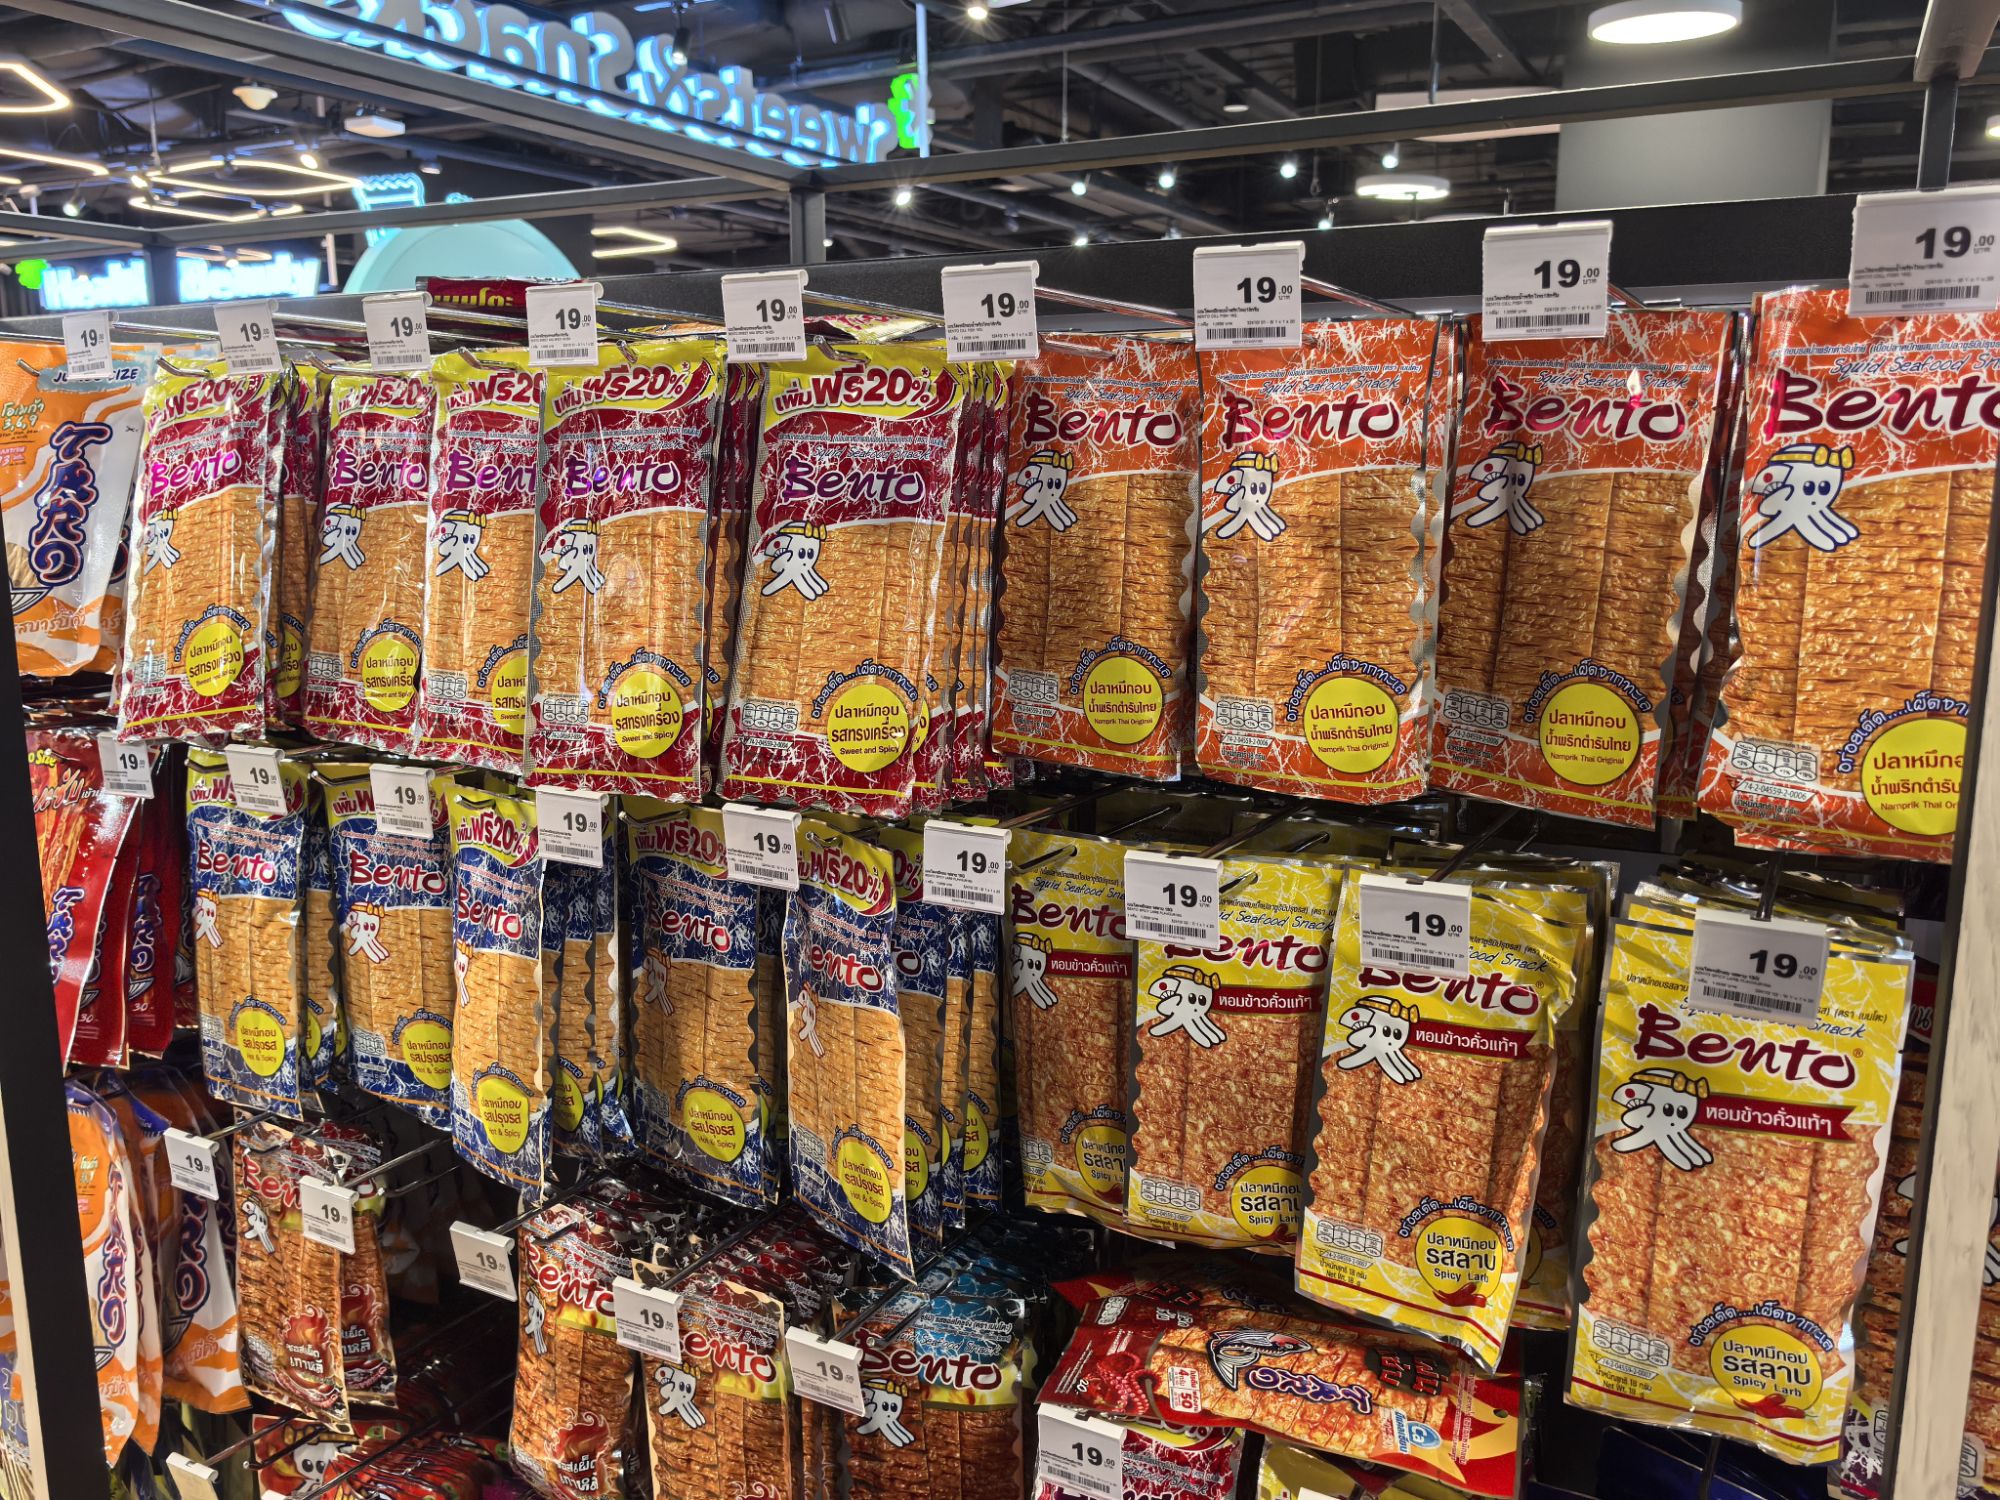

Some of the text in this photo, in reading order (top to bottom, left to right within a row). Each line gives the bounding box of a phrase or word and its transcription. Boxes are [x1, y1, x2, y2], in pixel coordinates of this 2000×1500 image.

[1915, 226, 1995, 259] 19 .00
[1534, 259, 1600, 289] 19 .00
[1237, 276, 1293, 303] 19 .00
[756, 298, 785, 323] 19
[981, 293, 1015, 318] 19
[391, 317, 413, 337] 19
[555, 308, 580, 330] 19
[81, 329, 98, 348] 19
[241, 323, 262, 344] 19
[1830, 355, 1967, 382] Squid Seafood
[1260, 374, 1401, 395] Squid Seafood Snack
[1535, 371, 1690, 389] Squid Snack
[1064, 386, 1092, 402] Squid
[1145, 387, 1182, 401] Snack
[1023, 391, 1184, 448] Bento
[1482, 375, 1687, 442] Bento
[1220, 390, 1402, 452] Bento
[151, 450, 241, 498] Bento
[332, 447, 428, 489] Bento
[447, 449, 537, 492] Bent
[563, 456, 680, 497] Bento
[782, 454, 926, 502] Bento
[28, 421, 113, 587] TARO
[1090, 680, 1152, 695] ปลาหมึกอบ
[616, 690, 671, 708] ปลาหมึกอบ
[1088, 696, 1157, 714] น้ำพริกตำรับไทย
[615, 703, 680, 731] รสทรงเครื่อง
[834, 703, 899, 719] ปลาหมึกอบ
[1310, 702, 1386, 720] ปลาหมึกอบ
[1549, 710, 1626, 729] ปลาหมึกอบ
[654, 731, 674, 741] Spicy
[831, 717, 906, 742] รสทรงเครื่อง
[1310, 723, 1393, 741] น้ำพริกตำรับไทย
[1546, 728, 1632, 752] น้ำพริกตำรับไทย
[840, 746, 899, 755] Sweet and Spicy
[1362, 742, 1390, 751] Original
[119, 753, 139, 770] 19
[1550, 752, 1625, 765] Namprik Thai Original
[1873, 749, 1964, 770] ปลาหมึกอ
[250, 767, 269, 785] 19
[395, 785, 416, 805] 19
[1880, 800, 1942, 812] Namprik Thai
[563, 812, 587, 833] 19
[753, 832, 780, 854] 19
[196, 842, 276, 884] Bento
[349, 851, 446, 895] Bento
[957, 850, 987, 874] 19
[1033, 876, 1060, 892] Squid
[1064, 881, 1104, 898] Seafood
[1163, 883, 1212, 907] 19 .00
[457, 884, 523, 938] Bento
[1235, 912, 1289, 928] Seafood
[1294, 916, 1334, 932] Snack
[1405, 911, 1463, 937] 19 .00
[1050, 957, 1128, 976] หอมข้าวคั่วแท้ๆ
[1501, 953, 1548, 972] Snack
[1749, 949, 1818, 979] 19 .00
[1218, 989, 1312, 1010] หอมข้าวคั่วแท้ๆ
[1415, 1027, 1518, 1053] หอมข้าวคั่วแท้ๆ
[1633, 1003, 1855, 1089] Bento
[1705, 1105, 1832, 1136] หอมข้าวคั่วแท้ๆ
[185, 1154, 204, 1172] 19
[242, 1149, 302, 1209] Ben
[321, 1204, 341, 1223] 19
[1248, 1215, 1273, 1225] Spicy
[1427, 1231, 1497, 1251] ปลาหมึกอบ
[476, 1251, 498, 1269] 19
[1426, 1248, 1496, 1271] รสลาบ
[1433, 1267, 1489, 1284] Spicy Larb
[640, 1308, 665, 1328] 19
[1722, 1339, 1808, 1365] ปลาหมึกอบ
[817, 1360, 844, 1381] 19
[1723, 1354, 1811, 1386] รสลาบ
[1244, 1365, 1373, 1415] TARO
[1732, 1374, 1802, 1397] Spicy Larb
[1181, 1392, 1193, 1409] 50
[1411, 1426, 1427, 1443] Ca
[1071, 1441, 1102, 1467] 19
